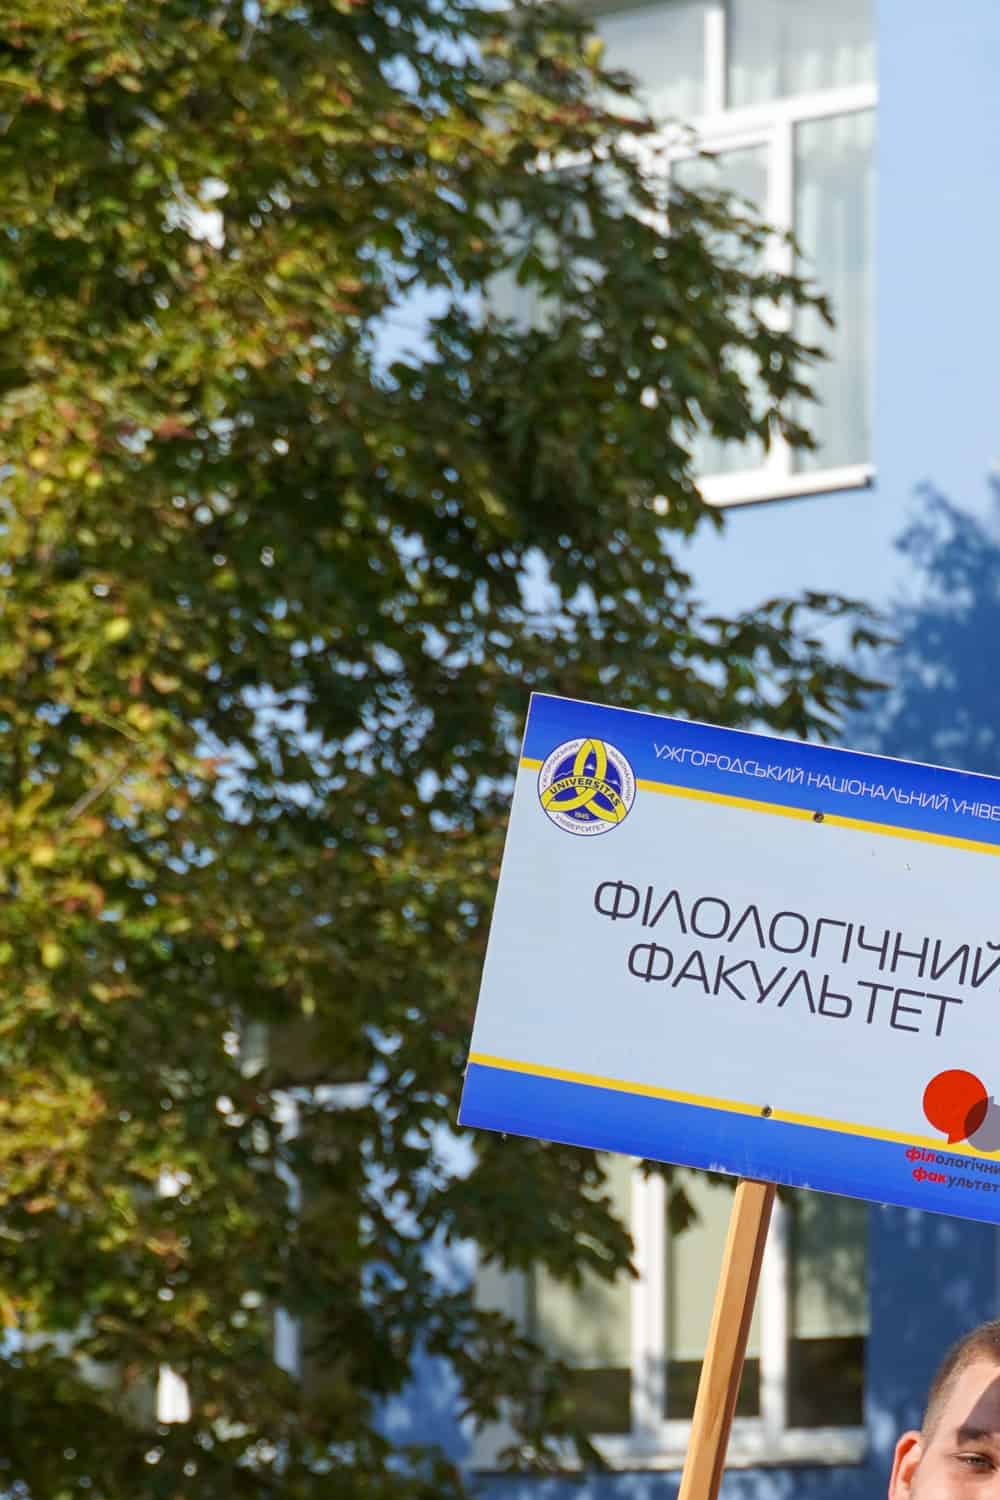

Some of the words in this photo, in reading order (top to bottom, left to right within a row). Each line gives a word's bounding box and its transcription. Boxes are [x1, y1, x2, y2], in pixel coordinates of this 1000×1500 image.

[549, 777, 620, 807] UNIVERSITAS
[654, 743, 804, 785] УЖГОРОДСЬКИЙ
[808, 772, 949, 811] НАЦІОНАЛЬНИЙ
[627, 942, 963, 1036] ФАКУЛЬТЕТ
[911, 1166, 1000, 1193] факультет
